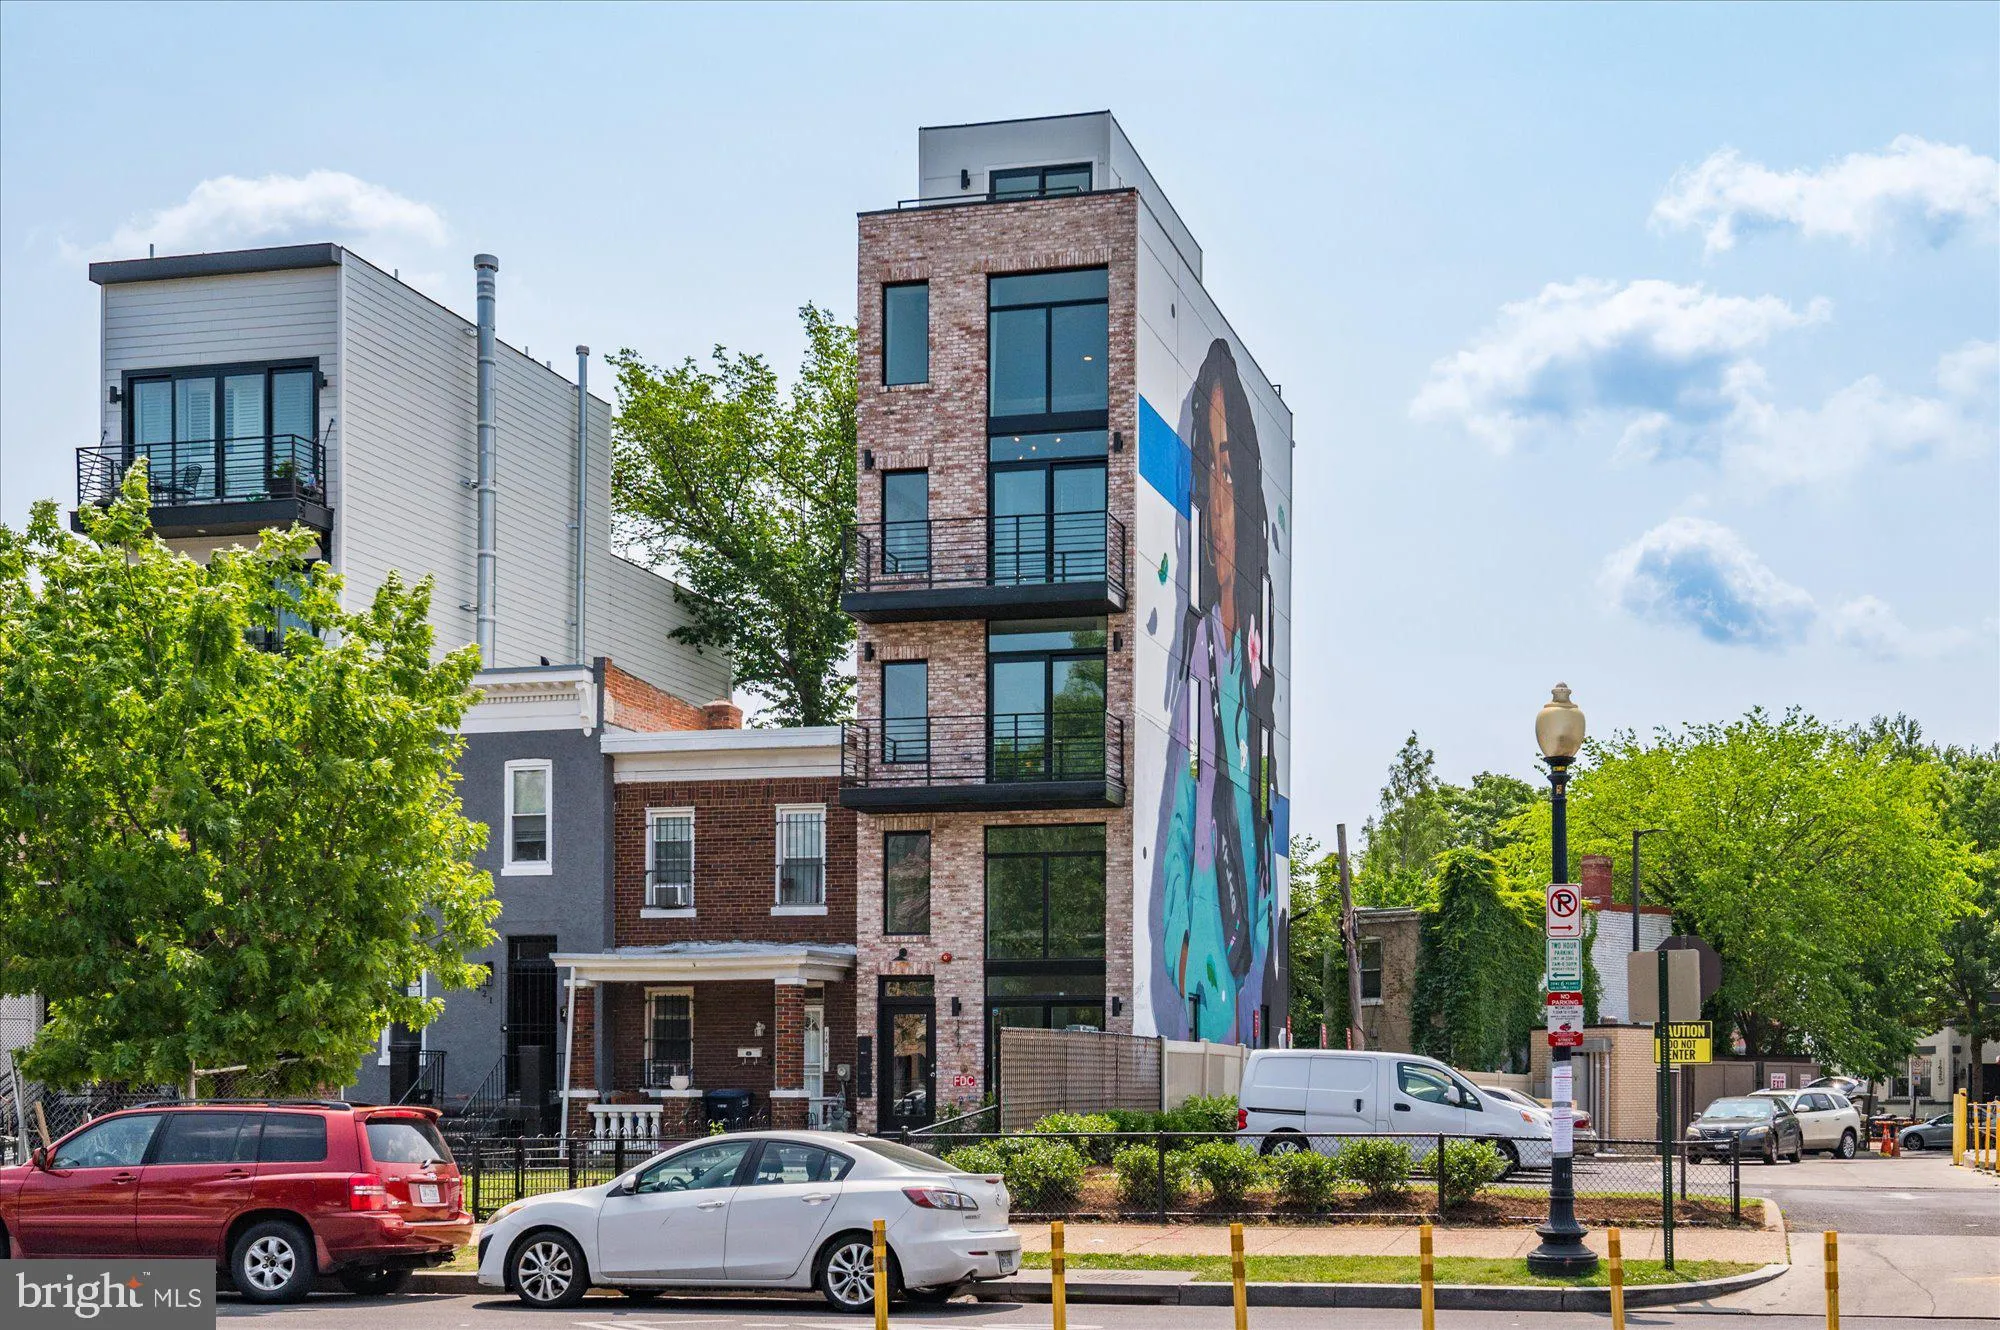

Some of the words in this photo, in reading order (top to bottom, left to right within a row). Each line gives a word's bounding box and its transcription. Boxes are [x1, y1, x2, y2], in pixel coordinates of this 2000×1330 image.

[1668, 1024, 1706, 1038] AUTION
[1681, 1040, 1696, 1049] NOT
[953, 1075, 974, 1086] FDC
